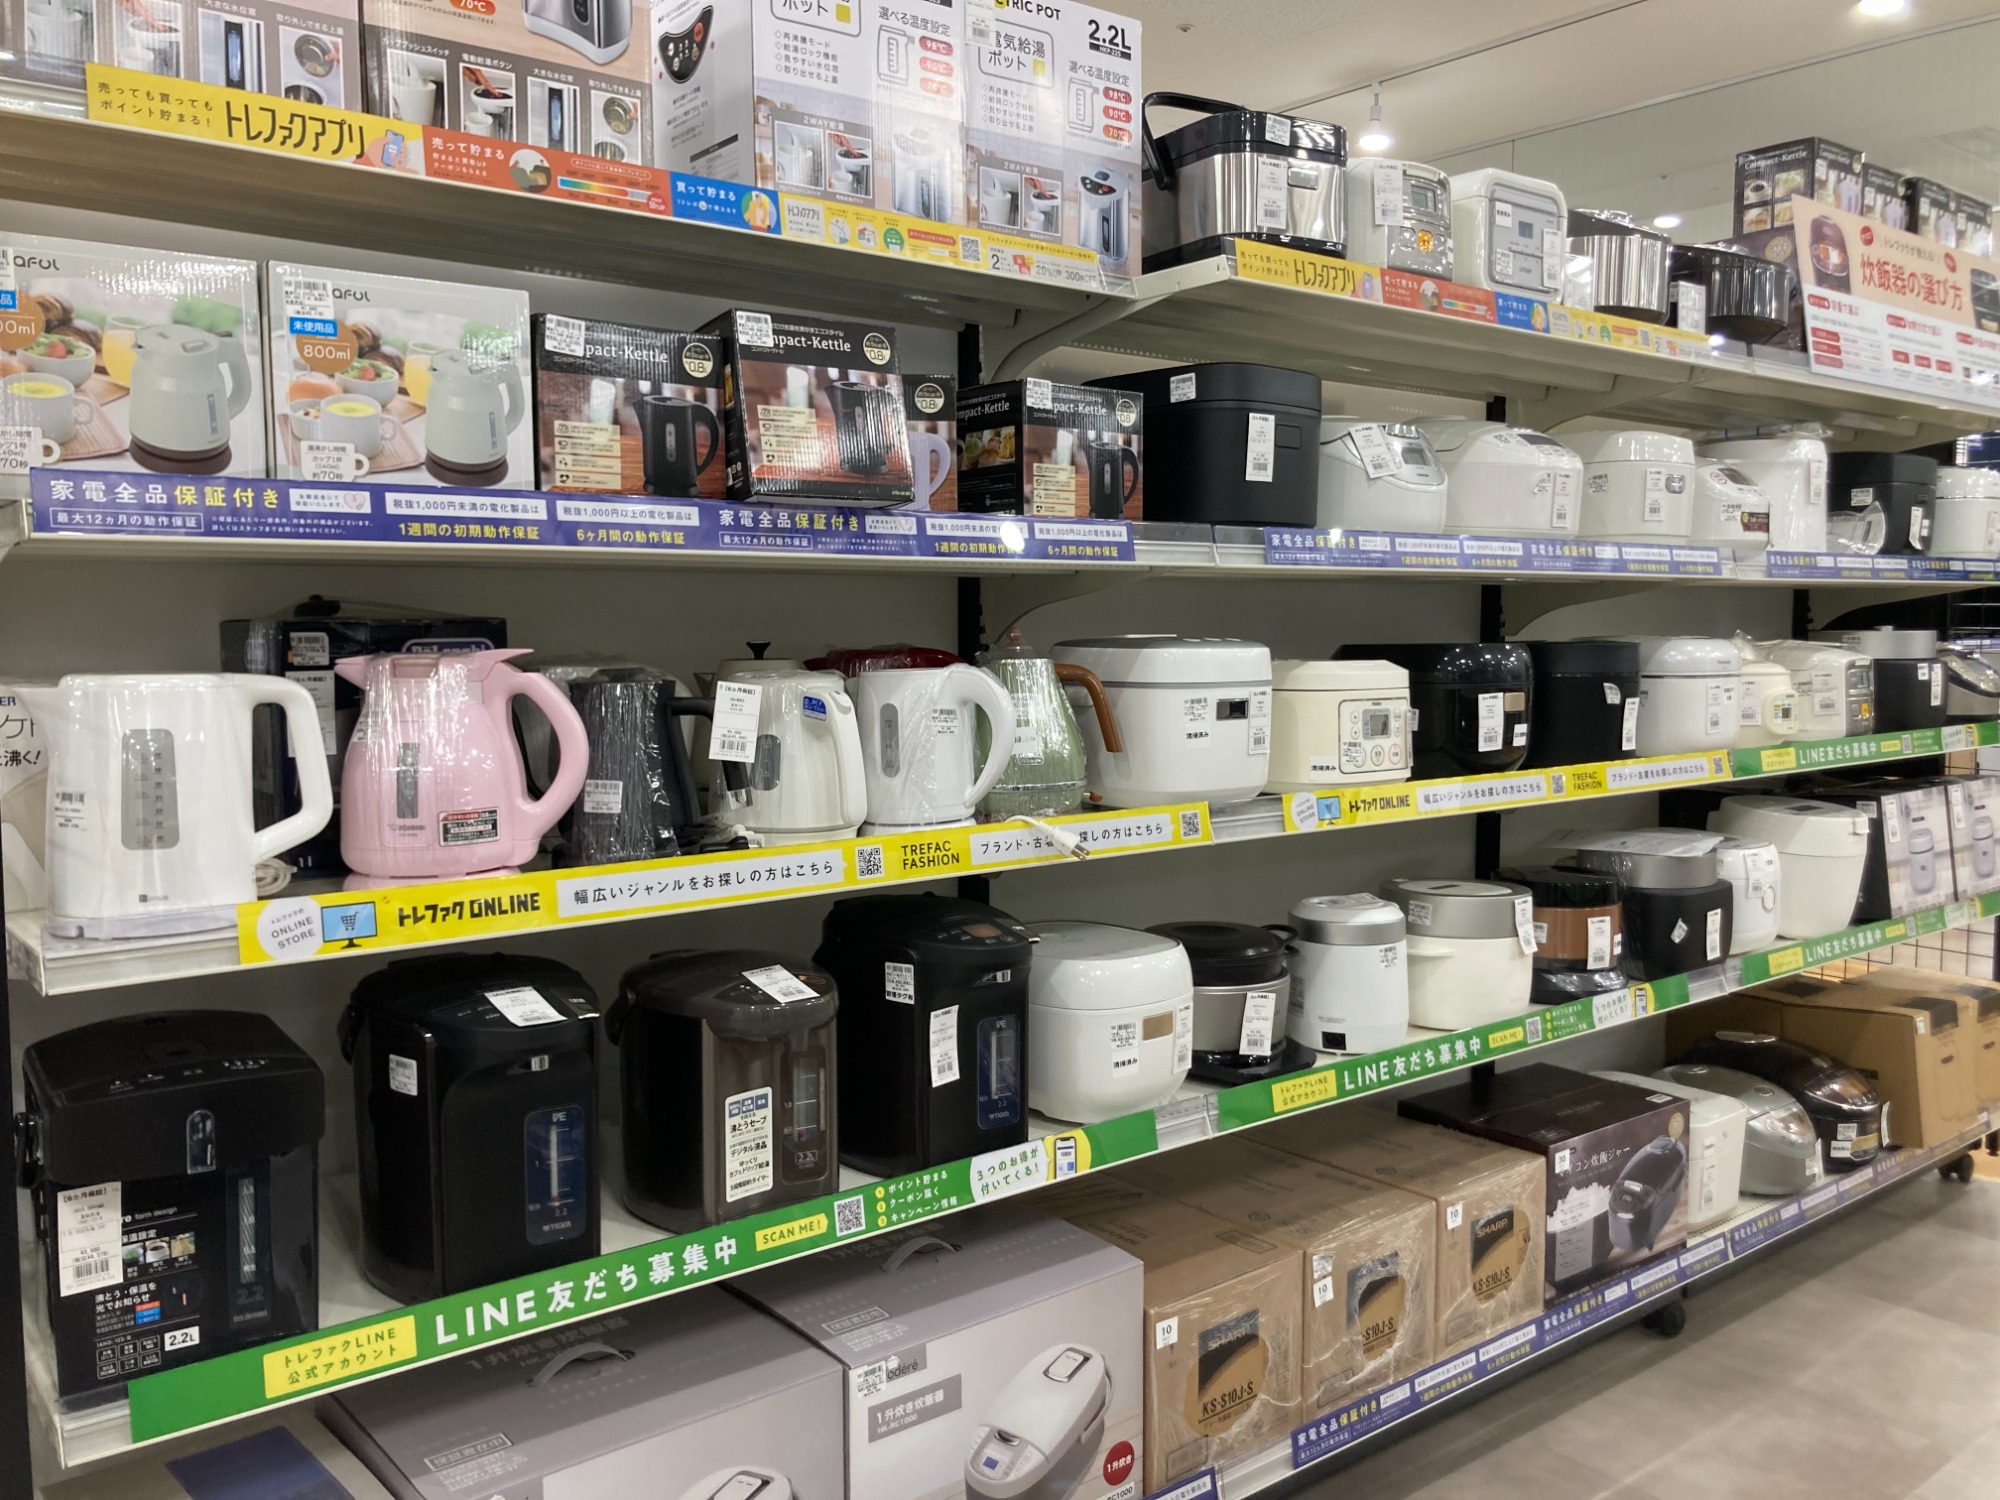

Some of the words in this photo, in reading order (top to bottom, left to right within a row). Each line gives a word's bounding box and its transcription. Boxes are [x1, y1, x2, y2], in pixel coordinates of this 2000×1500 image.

[878, 6, 950, 36] 選べる温度設定
[1036, 4, 1061, 21] POT
[1088, 19, 1132, 49] 2.2L
[988, 49, 1027, 71] ポット
[1068, 60, 1130, 87] 選べる温度設定
[98, 82, 213, 112] 売っても買っても
[225, 100, 366, 159] トレファクアプリ
[432, 136, 505, 161] 売って貯まる
[676, 181, 737, 202] 買って貯まる
[1294, 258, 1356, 293] トレファクアプリ
[1860, 253, 1964, 312] 炊飯器の選び方
[293, 319, 335, 335] 未使用品
[303, 345, 351, 361] 800ml
[50, 479, 280, 509] 家電全品保証付き
[393, 498, 540, 515] 税抜1,000円未満の電化製品は
[563, 505, 693, 522] 税抜1,000円以上の電化製品は
[719, 508, 859, 532] 家電全品保証付き
[398, 522, 540, 541] 1週間の初期動作保証
[1572, 771, 1598, 782] TREFAC
[1573, 781, 1602, 792] FASHION
[1424, 781, 1542, 805] 幅広いジャンルをお探しの方はこちら
[902, 840, 952, 857] TREFAC
[902, 854, 960, 871] FASHION
[574, 860, 834, 906] 幅広いジャンルをお探しの方はこちら
[271, 916, 314, 939] ONLINE
[277, 929, 316, 950] STORE
[731, 1141, 768, 1157] デジタル液晶
[1557, 1153, 1567, 1165] 30
[739, 1156, 758, 1168] ゆっくり
[976, 1146, 1039, 1181] 3つのお得が
[888, 1170, 948, 1194] ポイント貯まる
[890, 1187, 940, 1208] クーポン届く
[136, 1212, 151, 1220] form
[153, 1206, 178, 1217] design
[891, 1196, 958, 1223] キャンペーン情報
[1450, 1208, 1459, 1219] 10
[762, 1225, 796, 1245] SCAN
[1476, 1217, 1509, 1239] SHARP
[435, 1234, 738, 1345] LINE友だち募集中
[1317, 1283, 1328, 1295] 10
[168, 1332, 196, 1347] 2.2L
[1161, 1324, 1172, 1336] 10
[284, 1326, 397, 1368] トレファクLINE
[288, 1344, 396, 1385] 公式アカウント
[877, 1388, 945, 1424] 1升炊き炊飯器
[1202, 1381, 1254, 1416] KS-S10J-S
[877, 1412, 919, 1435] HK-RC1000
[1297, 1399, 1378, 1446] 家電全品保証付き
[1106, 1454, 1132, 1473] 1升炊き
